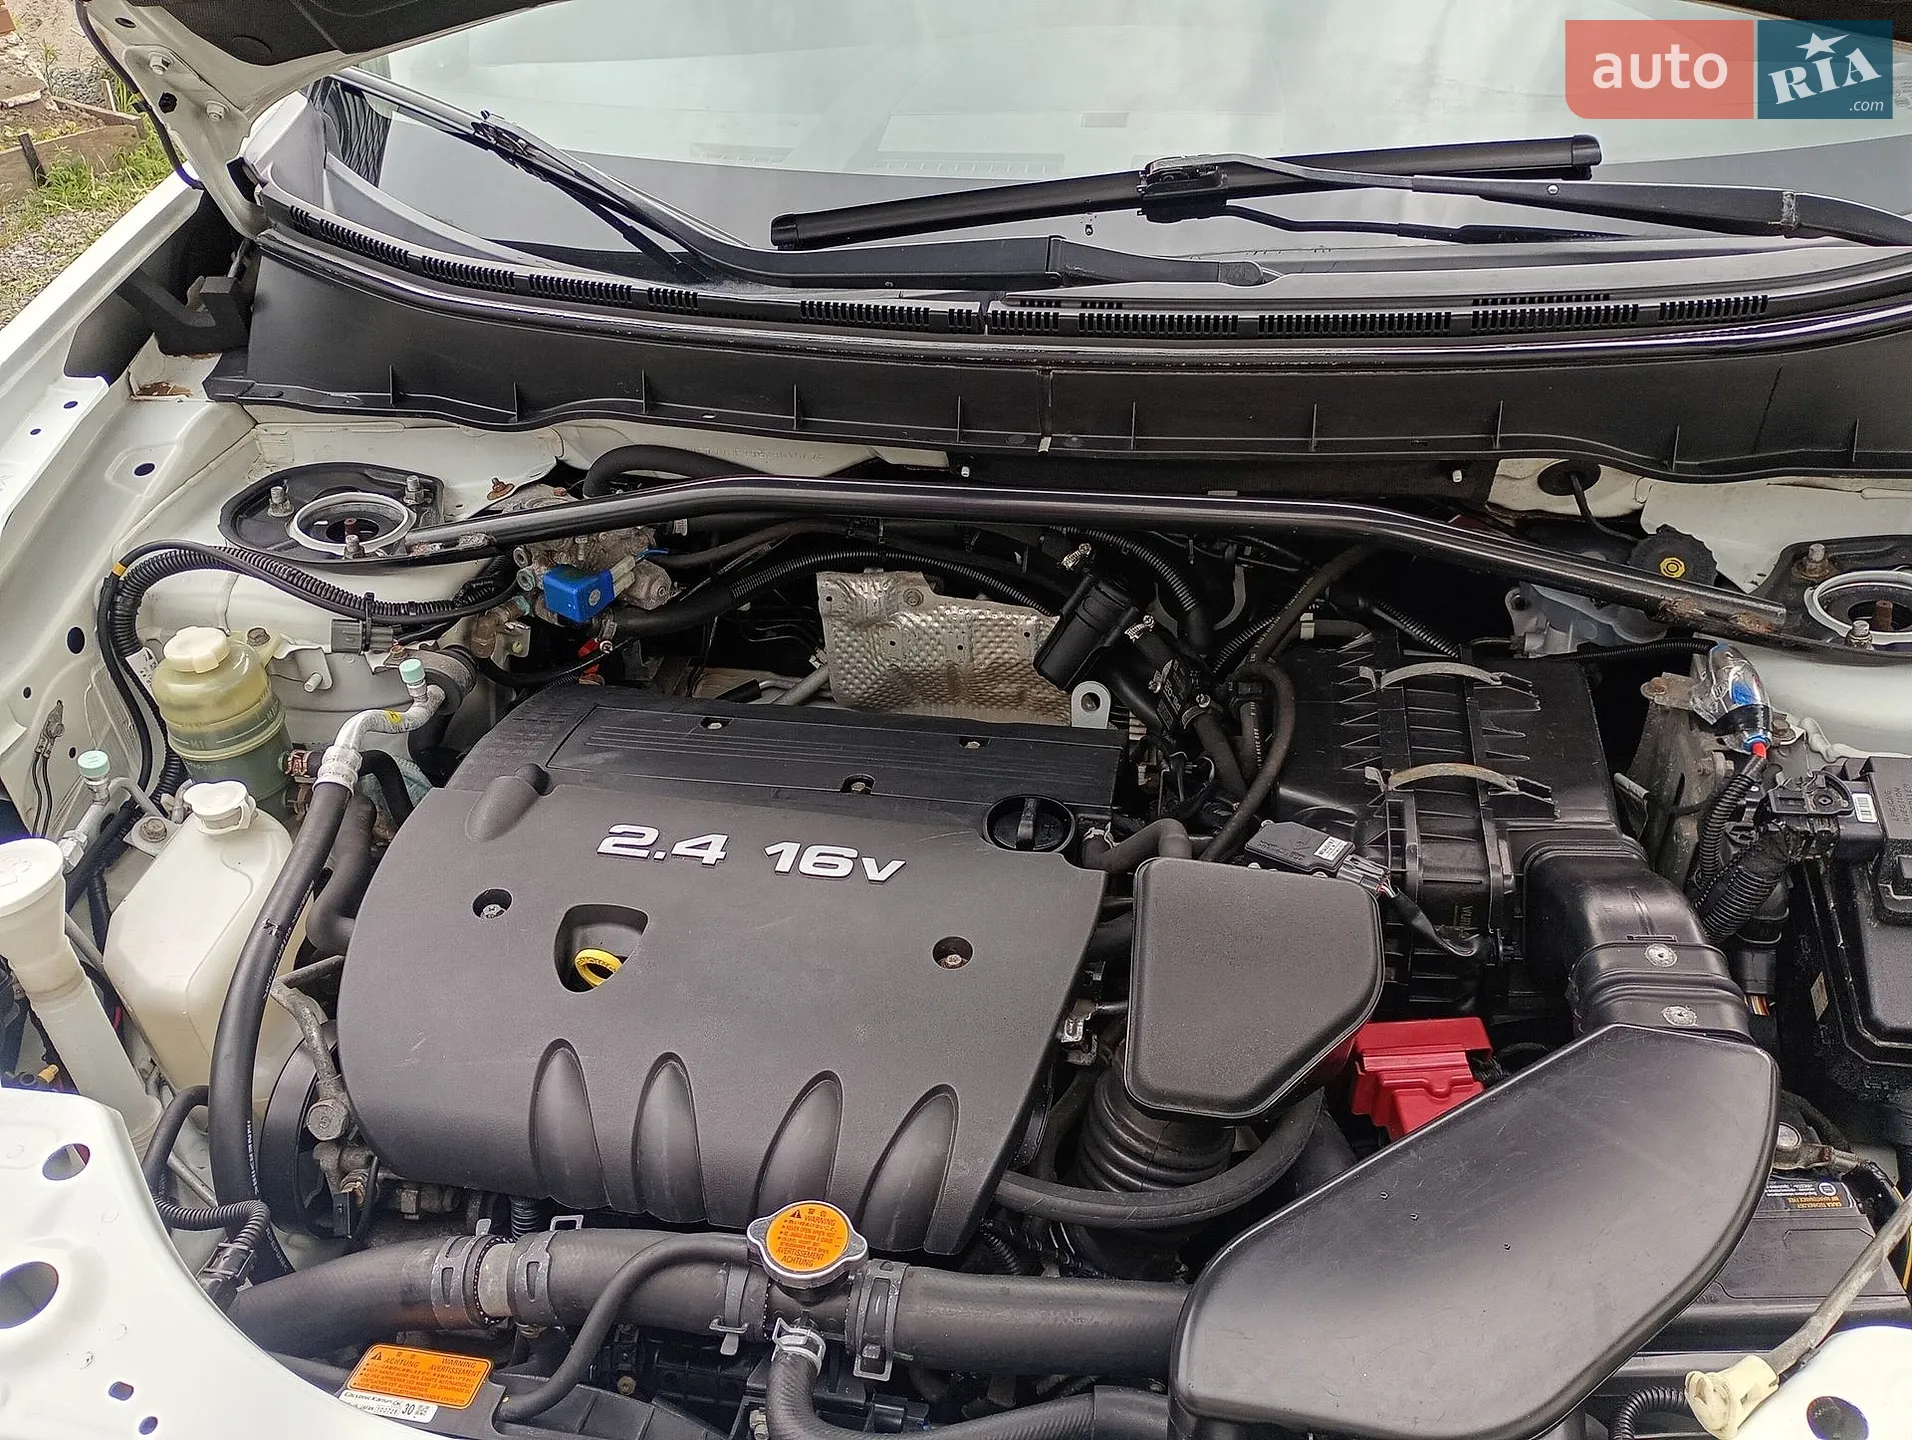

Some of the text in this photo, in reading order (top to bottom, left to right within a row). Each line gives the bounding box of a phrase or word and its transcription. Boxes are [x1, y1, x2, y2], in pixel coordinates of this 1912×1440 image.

[596, 823, 729, 867] 2.4
[805, 1215, 837, 1227] WARNING
[776, 1247, 825, 1261] AVERTISSEMENT
[781, 1255, 814, 1267] ACHTUNG
[384, 1357, 420, 1368] ACHTUNG
[442, 1358, 477, 1368] WARNING
[429, 1364, 481, 1377] AVERTISSEMENT
